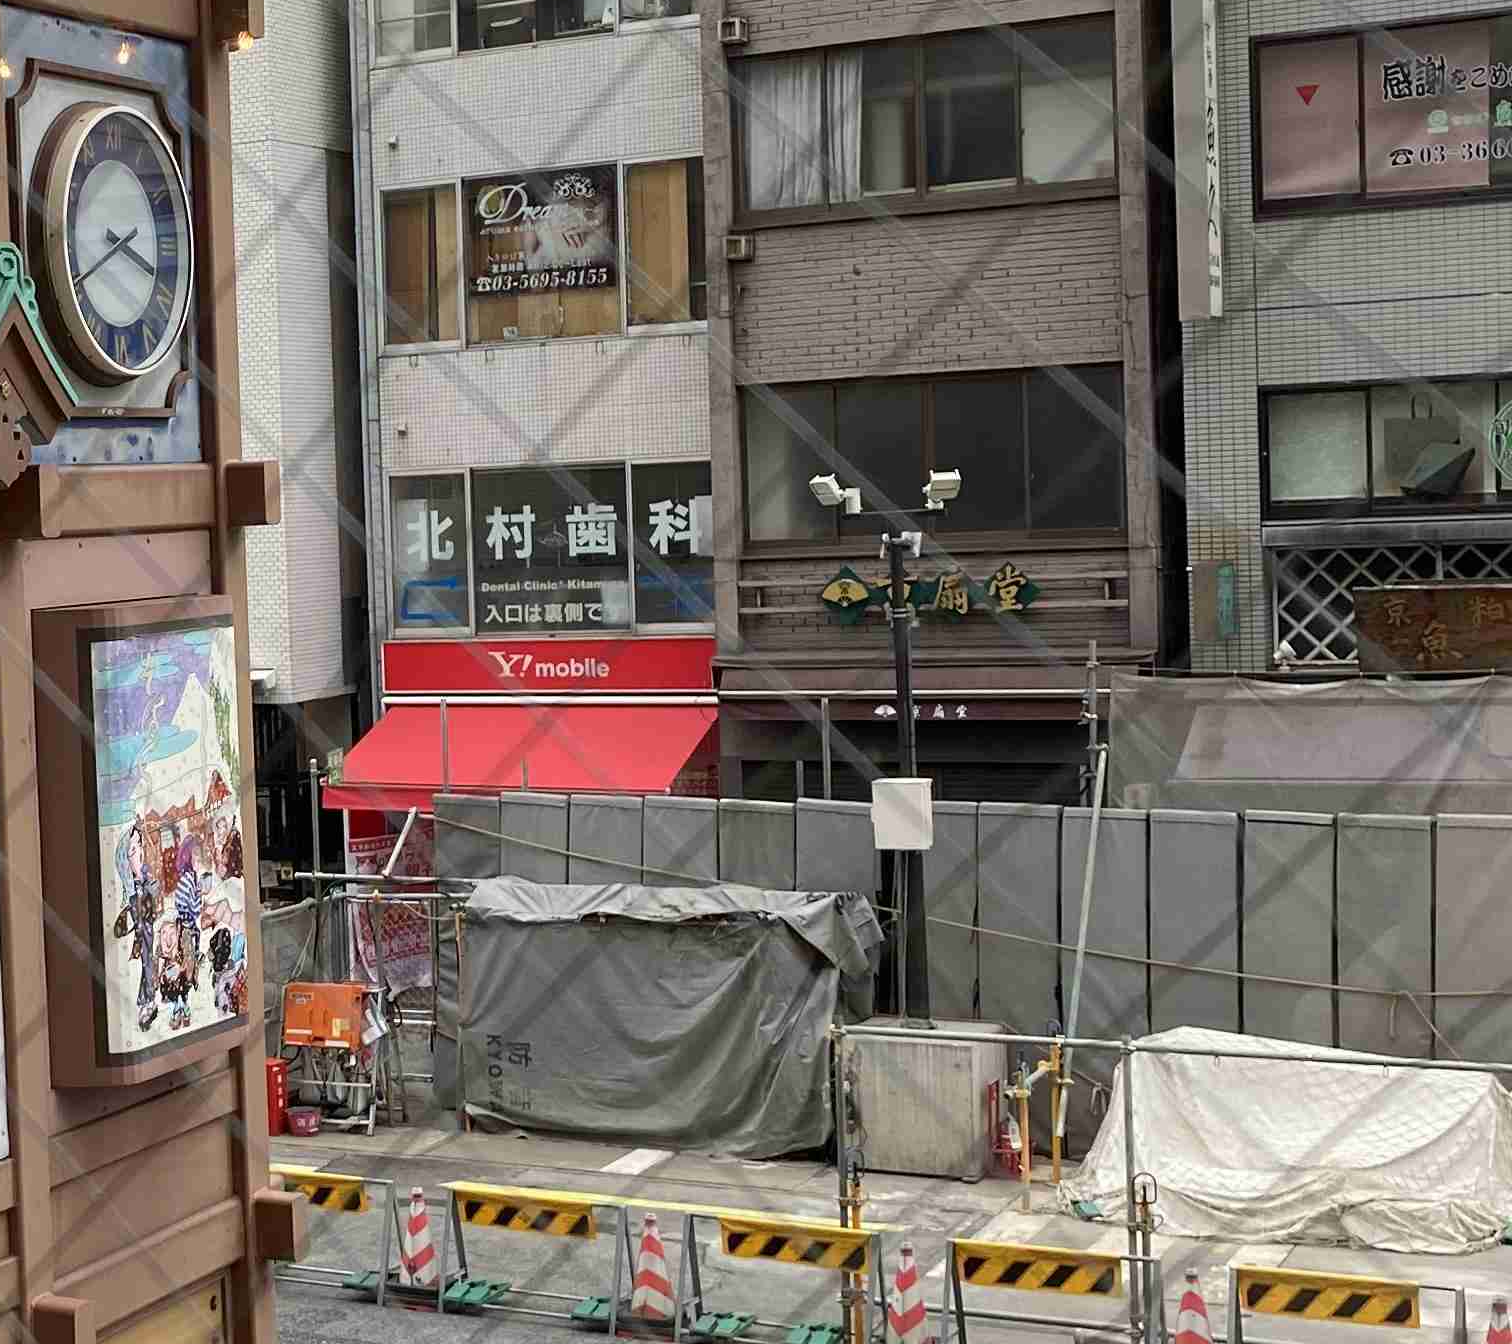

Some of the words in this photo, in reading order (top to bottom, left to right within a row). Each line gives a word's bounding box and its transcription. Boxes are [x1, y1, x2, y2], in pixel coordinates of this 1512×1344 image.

[491, 268, 608, 291] 03-5695-8155
[407, 498, 703, 560] 北村歯科
[481, 581, 520, 592] Dental
[484, 603, 618, 623] 入口は裏側で
